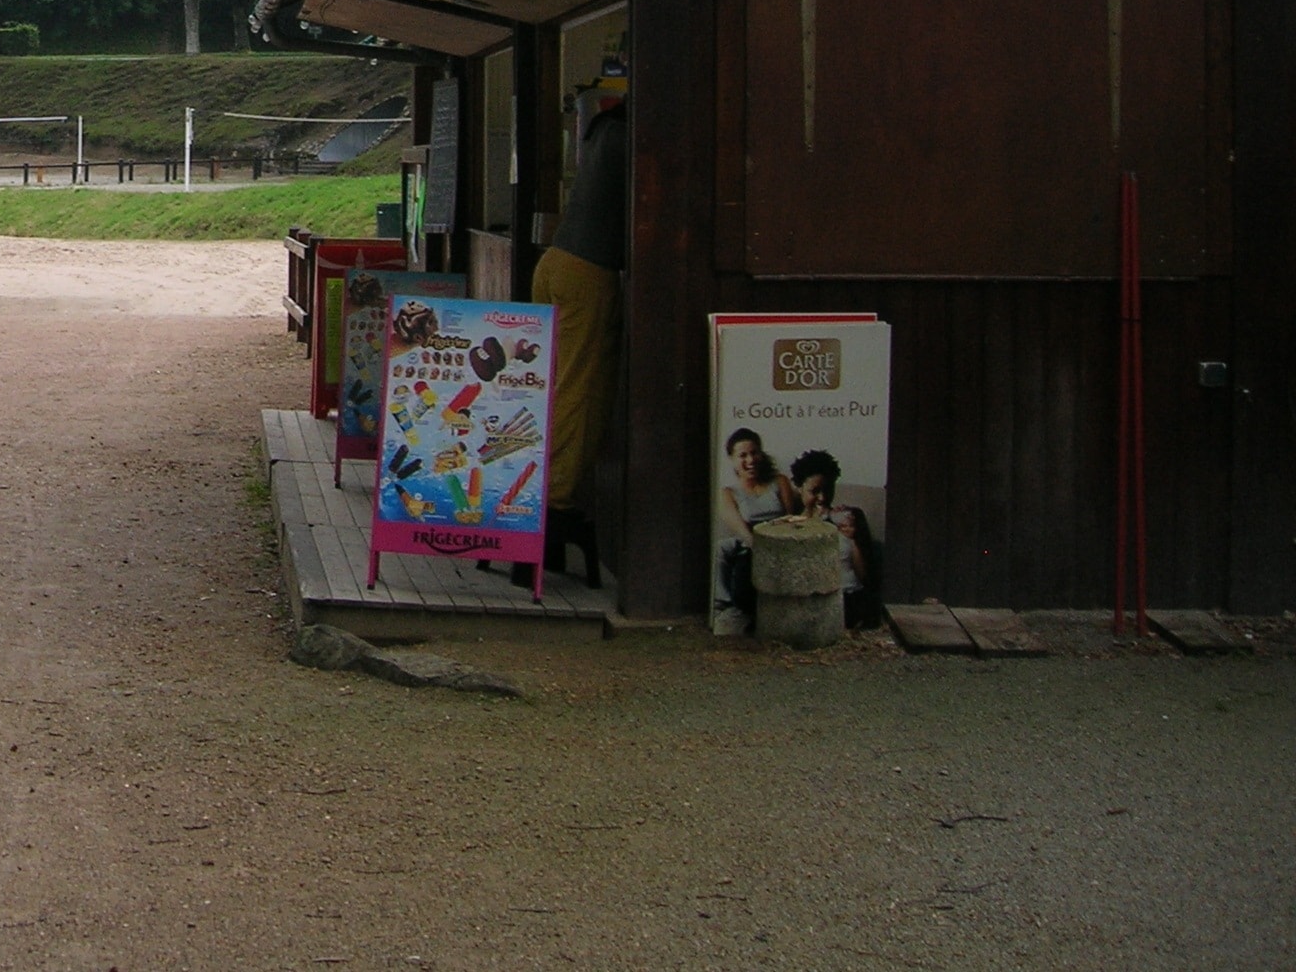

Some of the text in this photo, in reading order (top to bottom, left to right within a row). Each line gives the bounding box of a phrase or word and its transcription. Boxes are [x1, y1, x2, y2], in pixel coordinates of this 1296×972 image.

[779, 352, 835, 370] CARTE
[785, 369, 830, 387] D'OR
[733, 406, 745, 419] le
[748, 402, 791, 419] Goût
[818, 406, 844, 418] état
[849, 400, 878, 417] Pur
